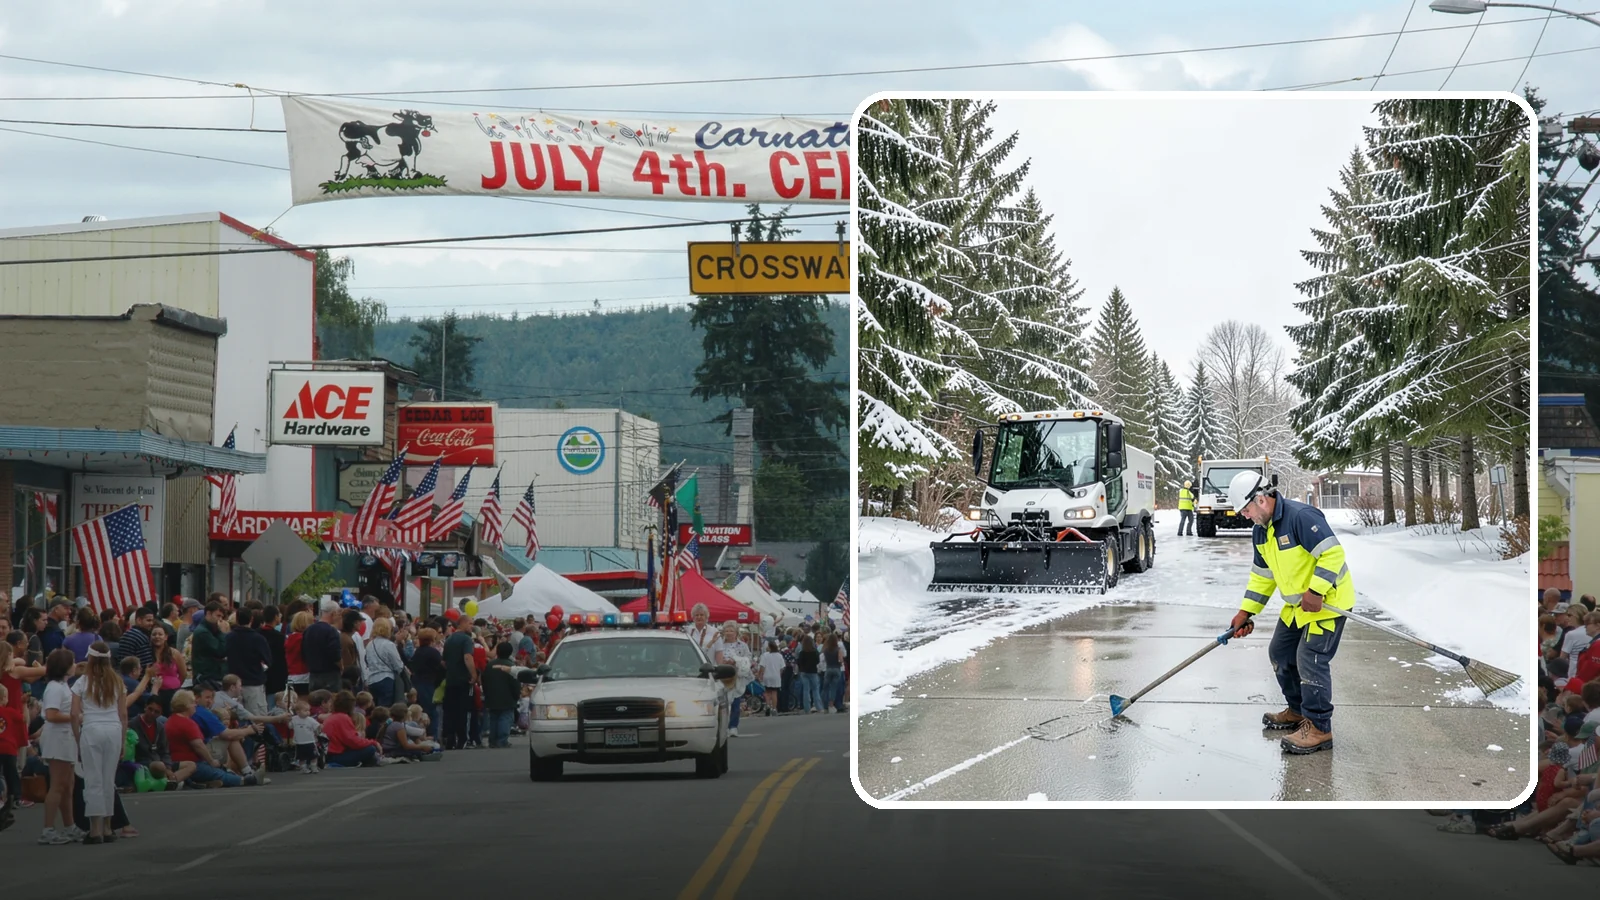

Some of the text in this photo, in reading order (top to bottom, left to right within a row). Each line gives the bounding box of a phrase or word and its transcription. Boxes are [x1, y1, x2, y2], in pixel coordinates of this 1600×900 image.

[481, 141, 604, 192] JULY
[633, 149, 747, 198] 4th.
[283, 380, 374, 420] ACE
[405, 408, 485, 422] CEDAR LOG
[283, 421, 371, 437] Hardware
[416, 428, 477, 447] Coca-Cola
[83, 485, 155, 495] St. Vincent de Paul
[688, 526, 741, 535] CRNATION
[699, 535, 731, 543] GLASS
